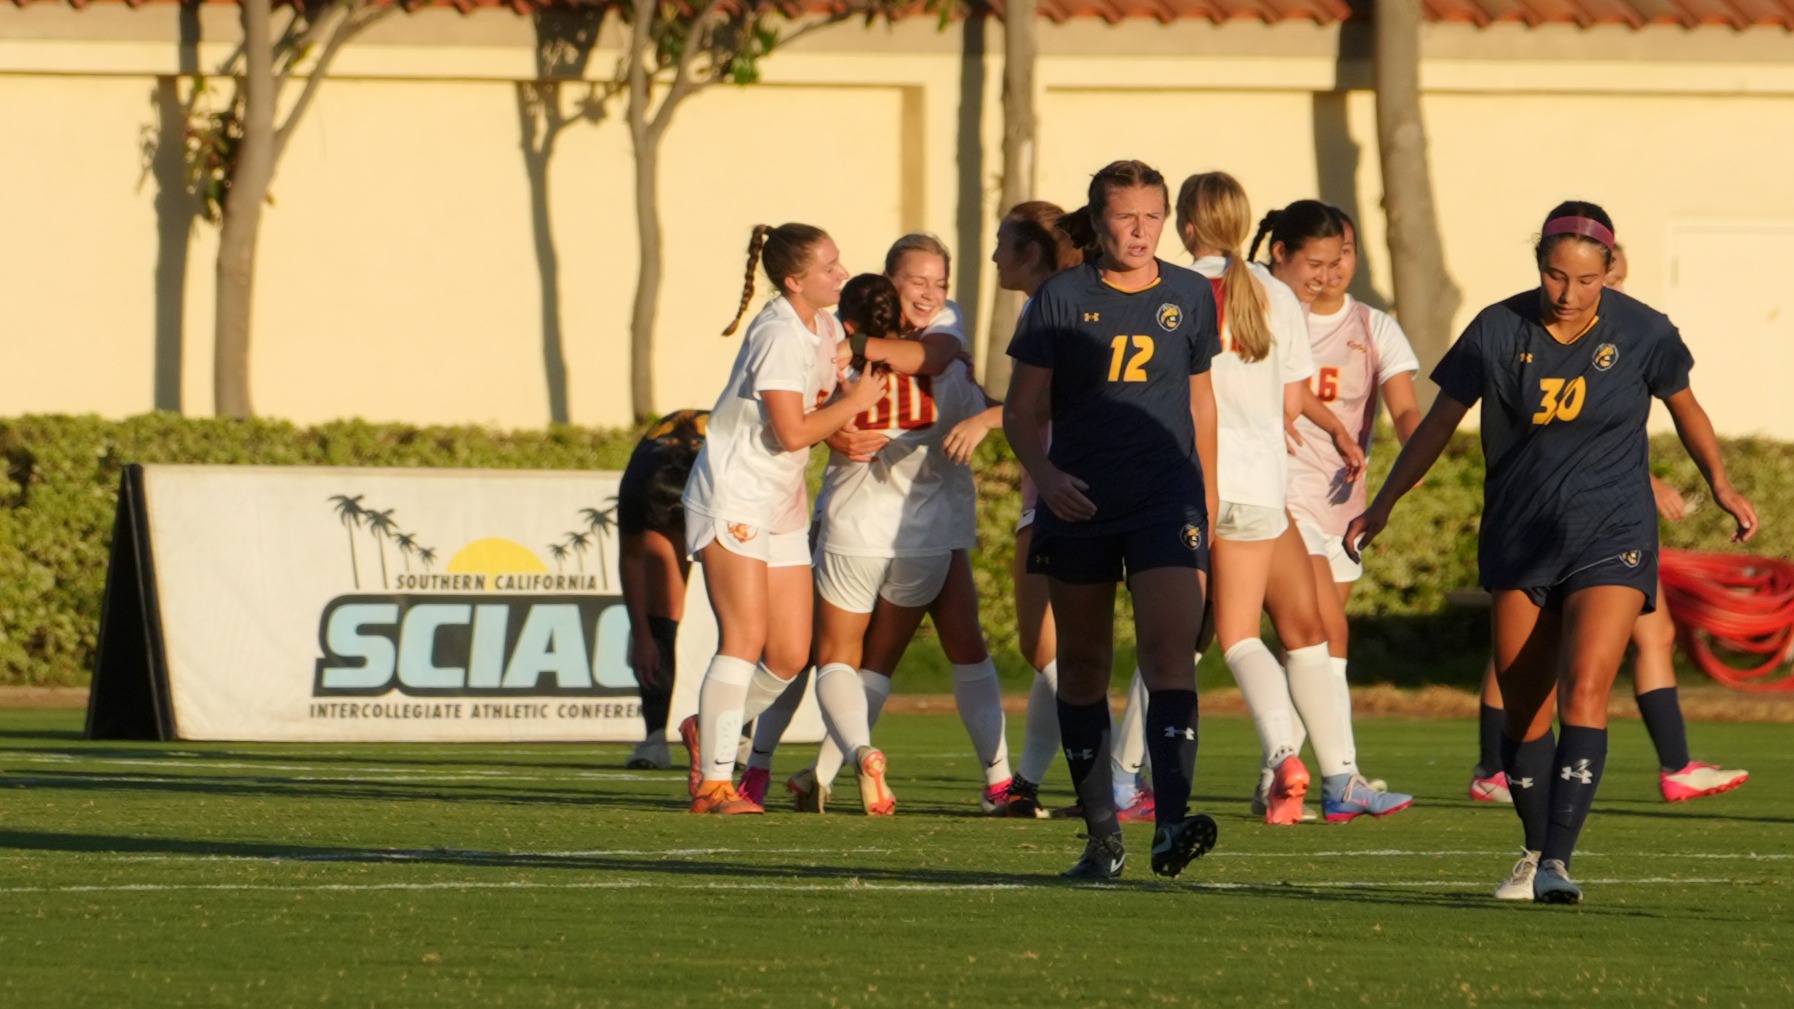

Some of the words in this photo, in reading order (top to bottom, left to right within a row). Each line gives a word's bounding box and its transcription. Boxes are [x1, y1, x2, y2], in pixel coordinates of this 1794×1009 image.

[1107, 335, 1155, 382] 12
[1308, 366, 1339, 402] 6
[1532, 376, 1587, 425] 30
[396, 574, 486, 590] SOUTHERN
[494, 574, 597, 590] CALIFORNIA
[310, 704, 462, 719] INTERCOLLEGIATE
[470, 704, 548, 719] ATHLETIC
